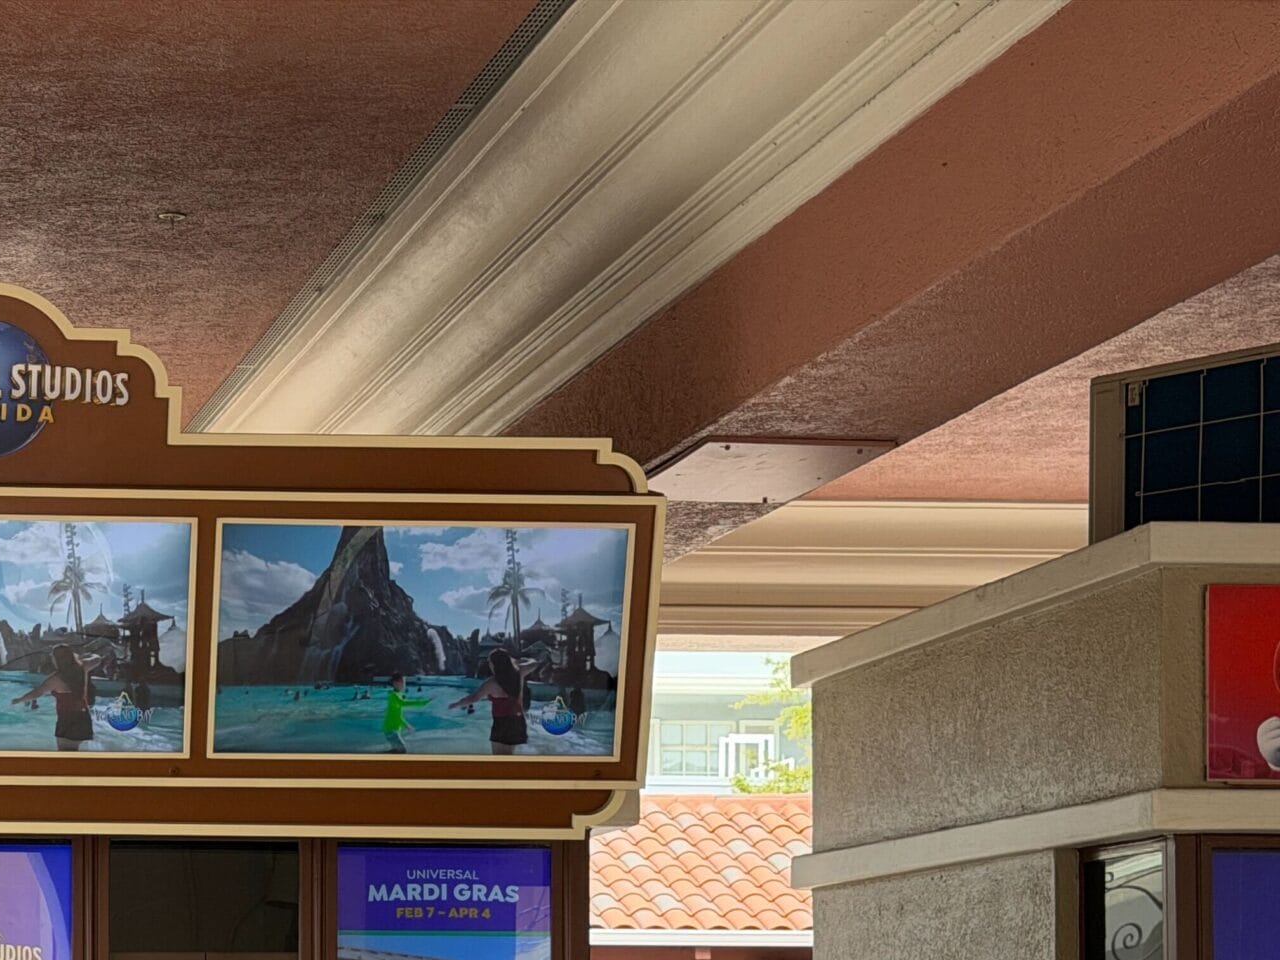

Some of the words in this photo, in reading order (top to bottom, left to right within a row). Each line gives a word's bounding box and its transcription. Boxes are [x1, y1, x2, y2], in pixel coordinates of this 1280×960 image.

[10, 362, 130, 406] STUDIOS
[406, 868, 480, 881] UNIVERSAL
[367, 882, 448, 903] MARDI
[452, 884, 521, 904] GRAS
[395, 906, 424, 919] FEB
[426, 906, 435, 919] 7
[448, 907, 480, 919] APR
[481, 907, 493, 919] 4
